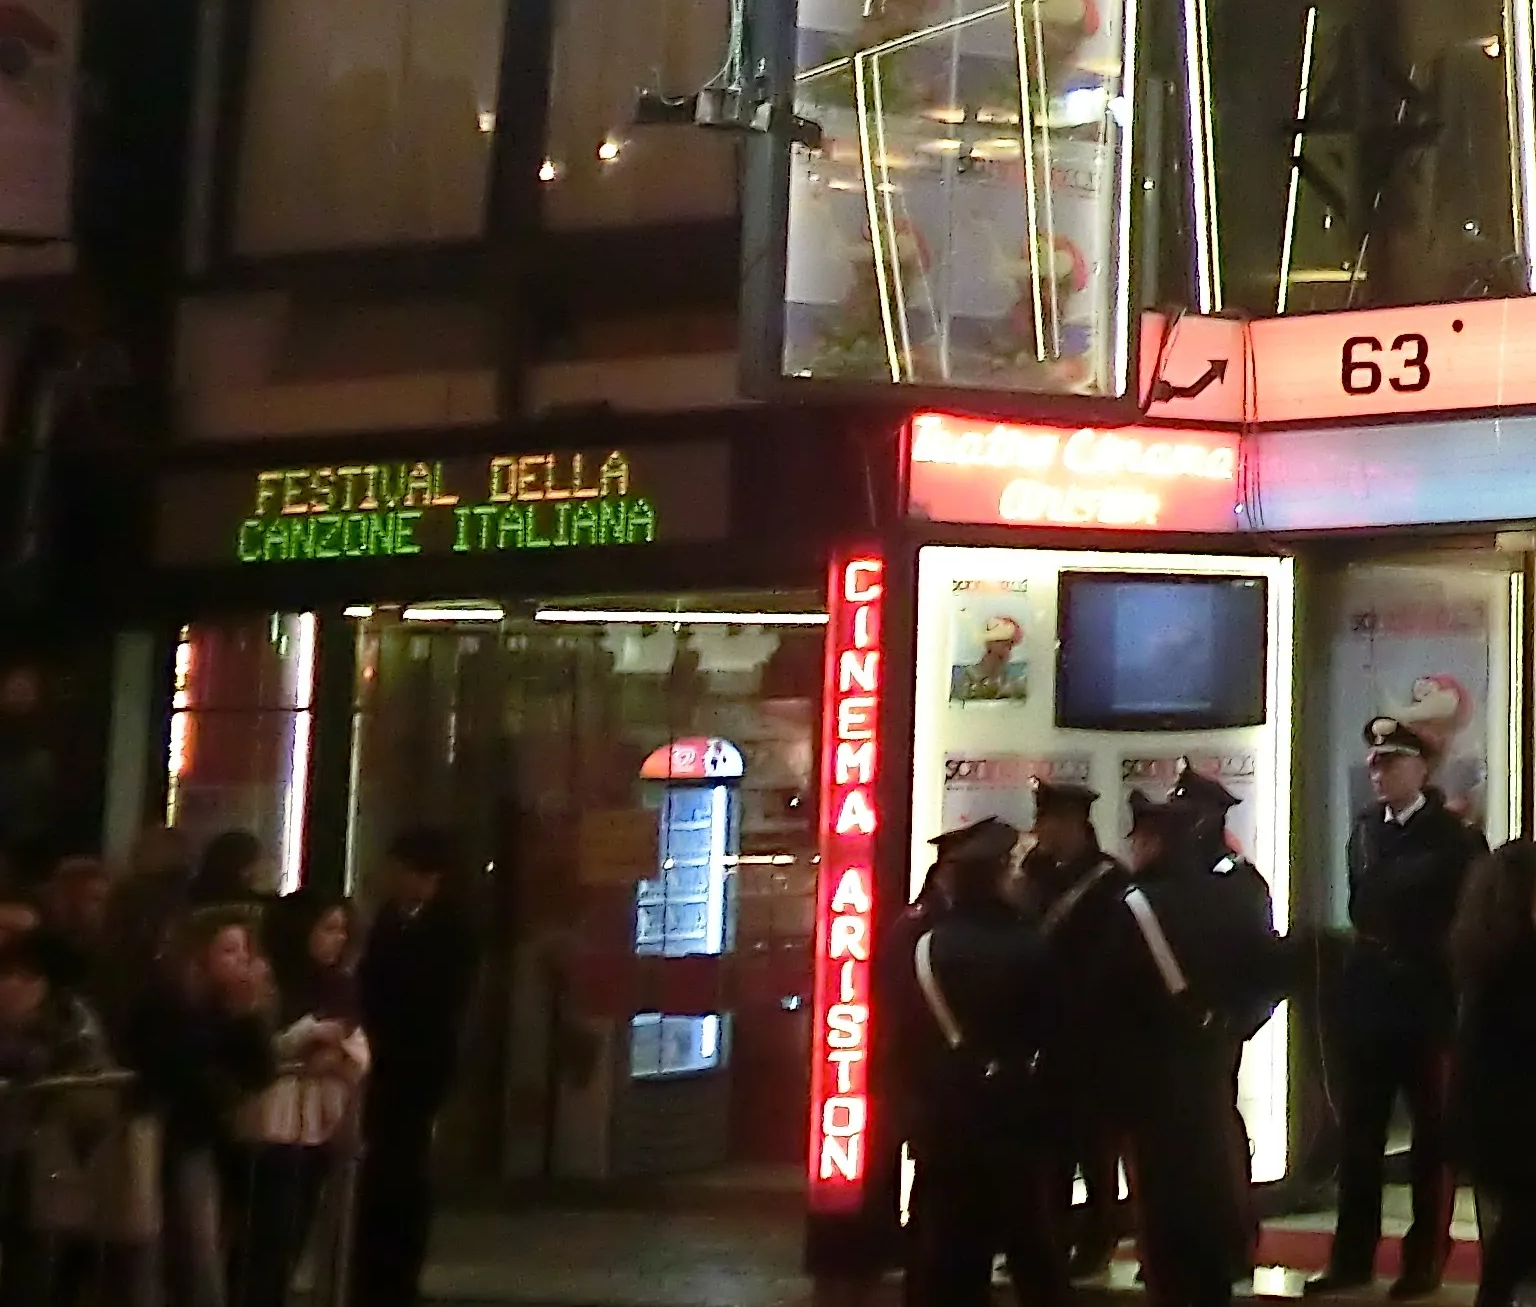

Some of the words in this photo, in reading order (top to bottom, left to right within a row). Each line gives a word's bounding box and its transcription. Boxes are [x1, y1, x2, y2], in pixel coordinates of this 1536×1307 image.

[236, 509, 424, 563] CANZONE
[452, 497, 657, 553] ITALIANA
[254, 460, 460, 516] FESTIVAL
[489, 450, 630, 503] DELLA
[835, 559, 884, 835] CINEMA
[819, 866, 870, 1181] ARISTON
